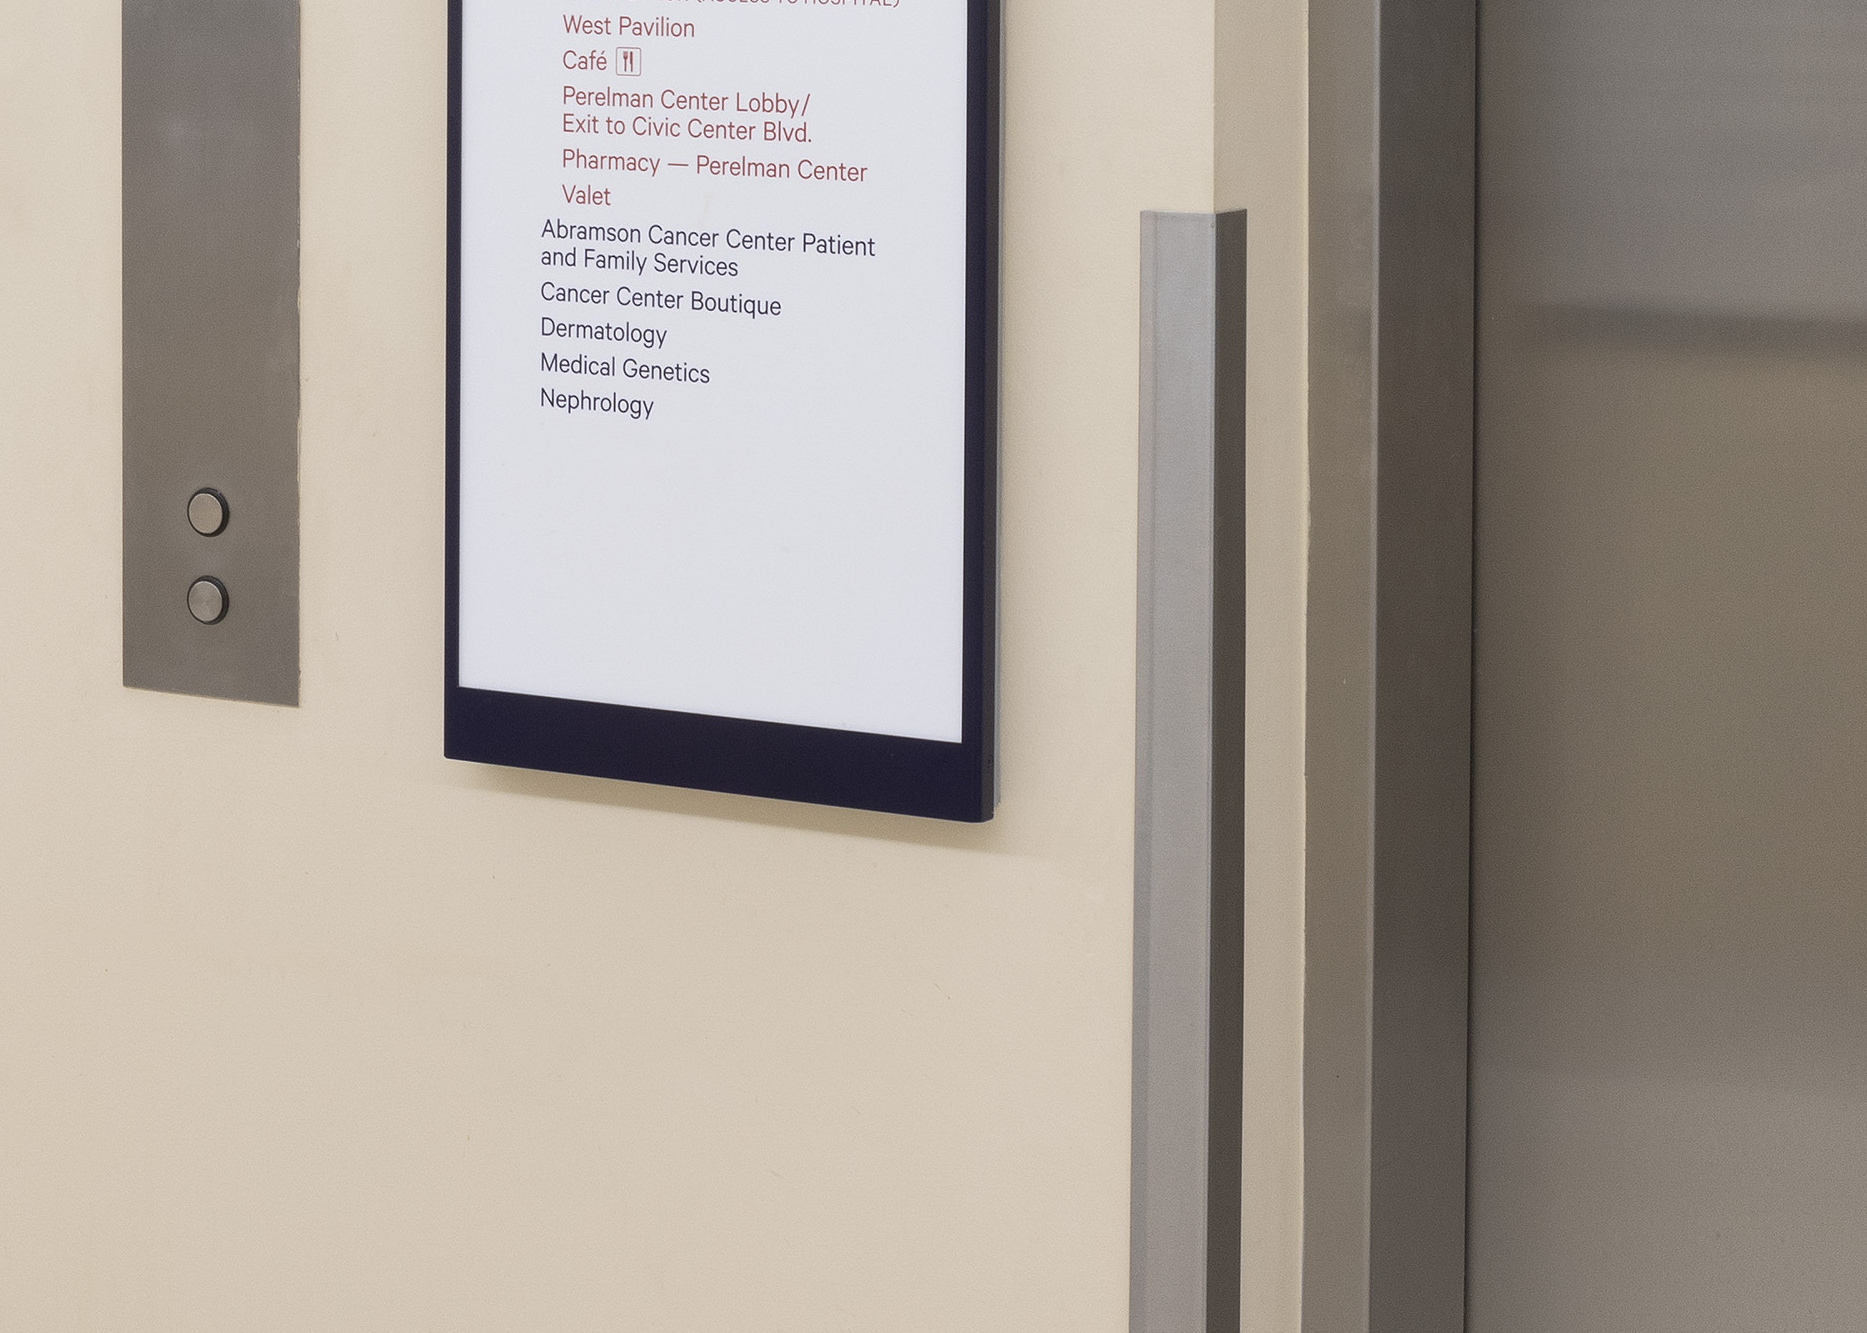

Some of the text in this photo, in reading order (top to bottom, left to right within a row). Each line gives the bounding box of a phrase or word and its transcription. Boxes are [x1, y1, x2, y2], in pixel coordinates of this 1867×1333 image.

[562, 14, 695, 38] West Pavilion
[562, 49, 608, 71] Café
[563, 85, 811, 120] Perelman Center Lobby/
[563, 112, 812, 143] Exit to Civic Center Blvd.
[562, 148, 661, 178] Pharmacy
[696, 154, 790, 179] Perelman
[797, 158, 868, 182] Center
[561, 184, 611, 206] Valet
[541, 218, 876, 257] Abramson Cancer Center Patient
[541, 246, 739, 277] and Family Services
[540, 281, 782, 320] Cancer Center Boutique
[541, 316, 668, 350] Dermatology
[541, 352, 710, 384] Medical Genetics
[540, 387, 655, 421] Nephrology
